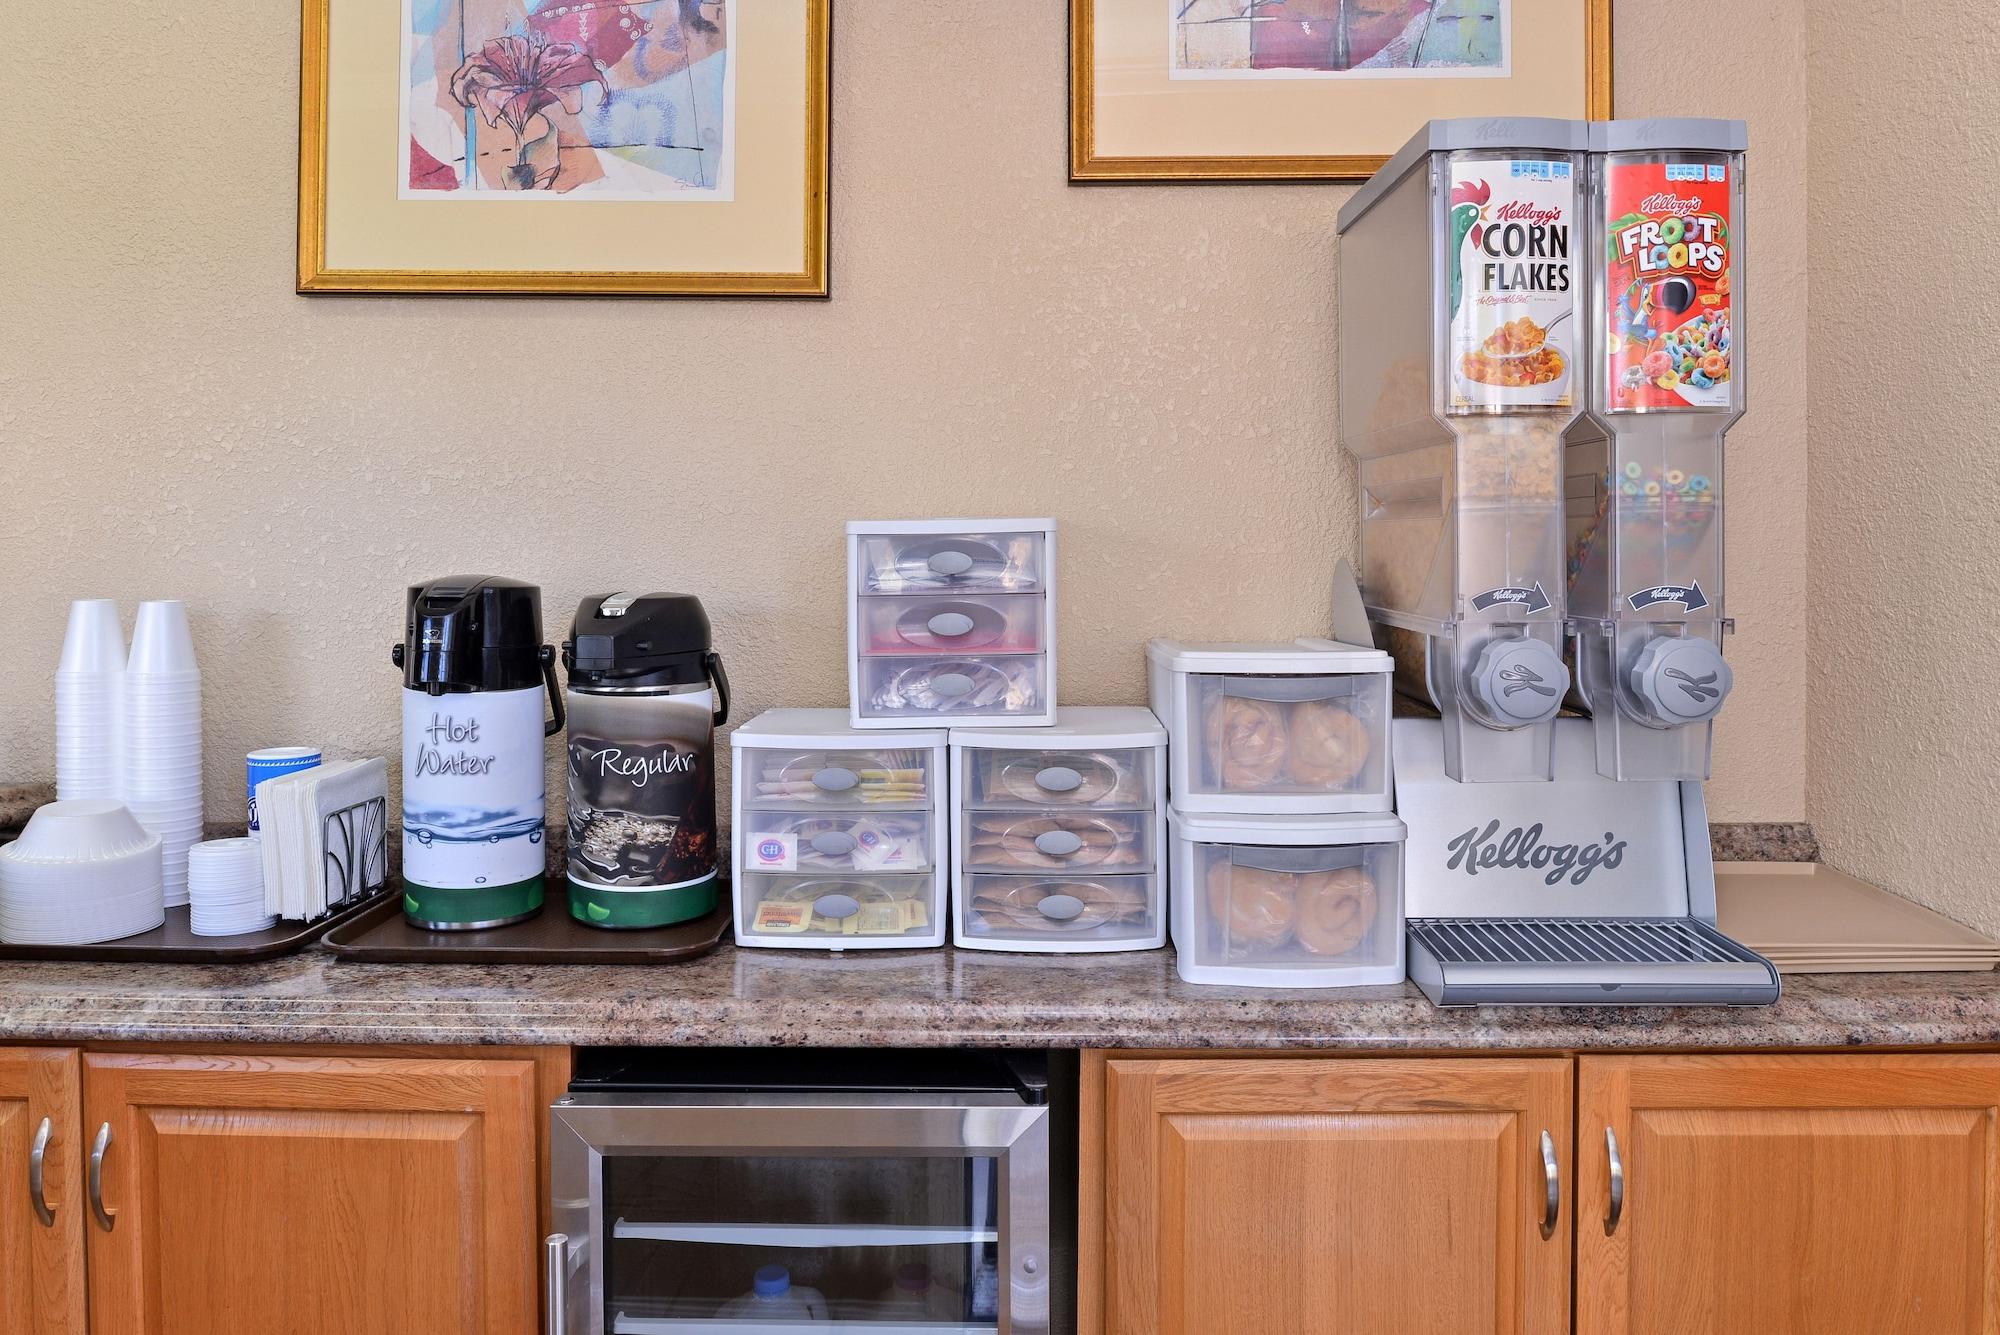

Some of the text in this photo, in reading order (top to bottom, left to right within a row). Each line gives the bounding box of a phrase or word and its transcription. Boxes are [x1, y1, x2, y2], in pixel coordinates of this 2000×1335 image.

[1496, 200, 1562, 225] Kellogg's
[1641, 192, 1702, 216] Kellogg's
[1482, 223, 1568, 259] CORN
[1621, 217, 1718, 256] FROOT
[1640, 242, 1725, 273] LOOPS
[1483, 263, 1569, 292] FLAKES
[1492, 588, 1528, 601] Kellogg's
[1650, 588, 1686, 601] Kellogg's
[425, 712, 480, 745] Hot
[415, 743, 496, 779] Water
[591, 748, 694, 788] Regular
[1447, 818, 1628, 886] Kellogg's
